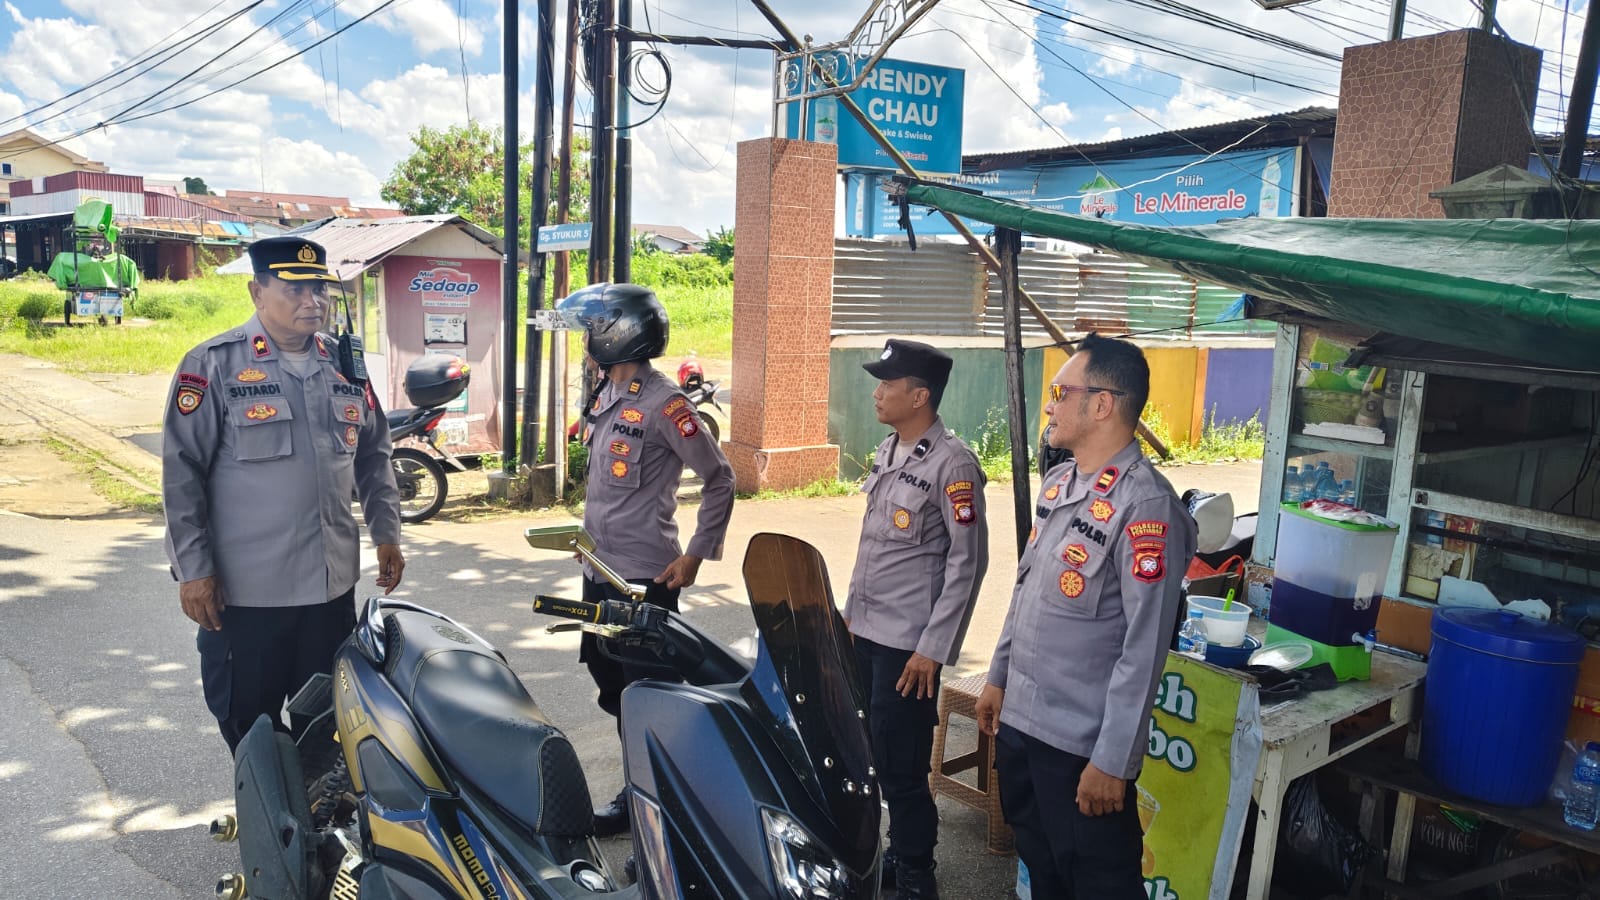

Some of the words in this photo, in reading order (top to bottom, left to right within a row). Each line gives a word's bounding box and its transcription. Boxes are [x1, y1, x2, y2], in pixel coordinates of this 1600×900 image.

[861, 66, 947, 98] RENDY
[867, 97, 939, 127] CHAU
[904, 131, 933, 142] Swieke
[1176, 174, 1205, 187] Pilih
[1093, 195, 1105, 206] Le
[1135, 194, 1158, 214] Le
[1161, 189, 1246, 213] Minerale
[1080, 205, 1119, 214] Minerale
[552, 230, 582, 240] SYUKUR
[418, 271, 435, 279] Mie
[409, 278, 480, 296] Sedaap
[229, 385, 281, 398] SUTARDI
[332, 384, 363, 397] POLRI
[611, 423, 644, 440] POLRI
[897, 472, 933, 493] POLRI
[1071, 517, 1107, 547] POLRI
